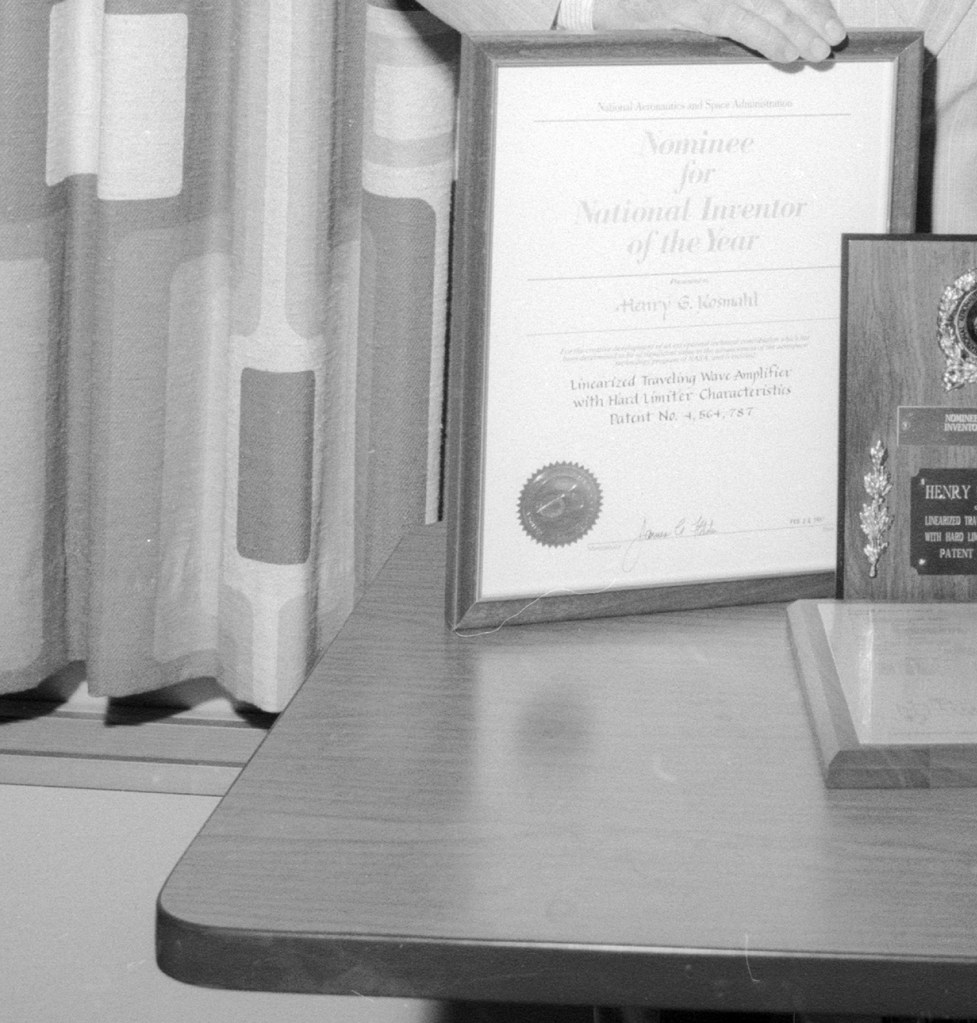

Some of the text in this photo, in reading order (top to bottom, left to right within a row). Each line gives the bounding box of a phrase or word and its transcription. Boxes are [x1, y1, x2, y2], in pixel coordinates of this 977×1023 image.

[598, 99, 793, 112] National Aeronautics and Space Administration
[644, 129, 755, 156] Nominee
[675, 159, 716, 194] for
[575, 195, 807, 225] National Inventor
[627, 227, 760, 265] of the Year
[615, 291, 759, 321] Henry G. Kosmahl
[570, 364, 793, 391] Linearized Traveling Wave Amplifier
[572, 383, 792, 408] with Hard Limiter Characteristics
[609, 411, 654, 426] Patent
[658, 409, 679, 422] No.
[925, 484, 971, 500] HENRY
[925, 515, 961, 526] LINEARIZED
[925, 532, 942, 542] WITH
[945, 532, 964, 542] HARD
[939, 548, 974, 559] PATENT
